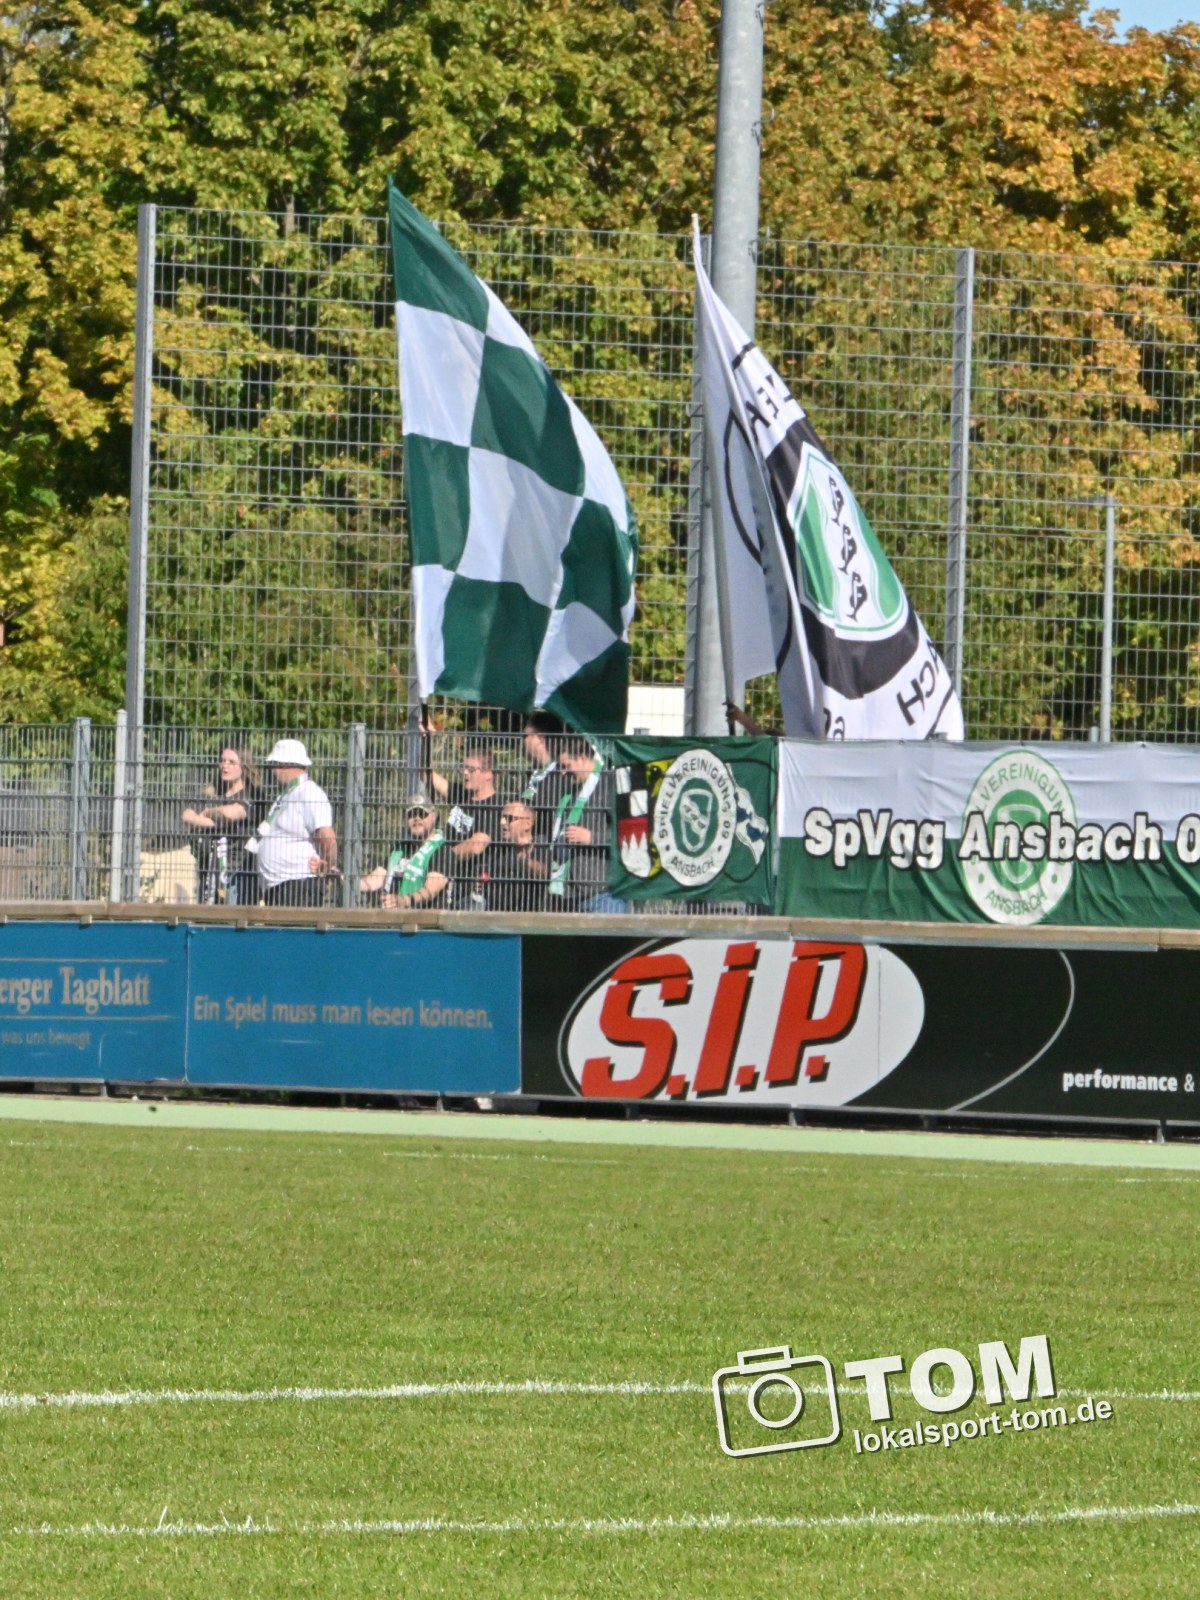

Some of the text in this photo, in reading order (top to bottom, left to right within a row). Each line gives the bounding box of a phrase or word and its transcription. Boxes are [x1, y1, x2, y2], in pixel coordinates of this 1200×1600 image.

[803, 806, 947, 871] SpVgg
[957, 810, 1163, 863] Ansbach
[670, 856, 714, 878] ANSBACH
[985, 889, 1047, 916] ANSBACH
[59, 966, 151, 1014] Tagblatt
[193, 995, 494, 1030] Ein Spiel muss man lesen können.
[2, 1031, 23, 1044] was
[1062, 1068, 1195, 1092] performance &
